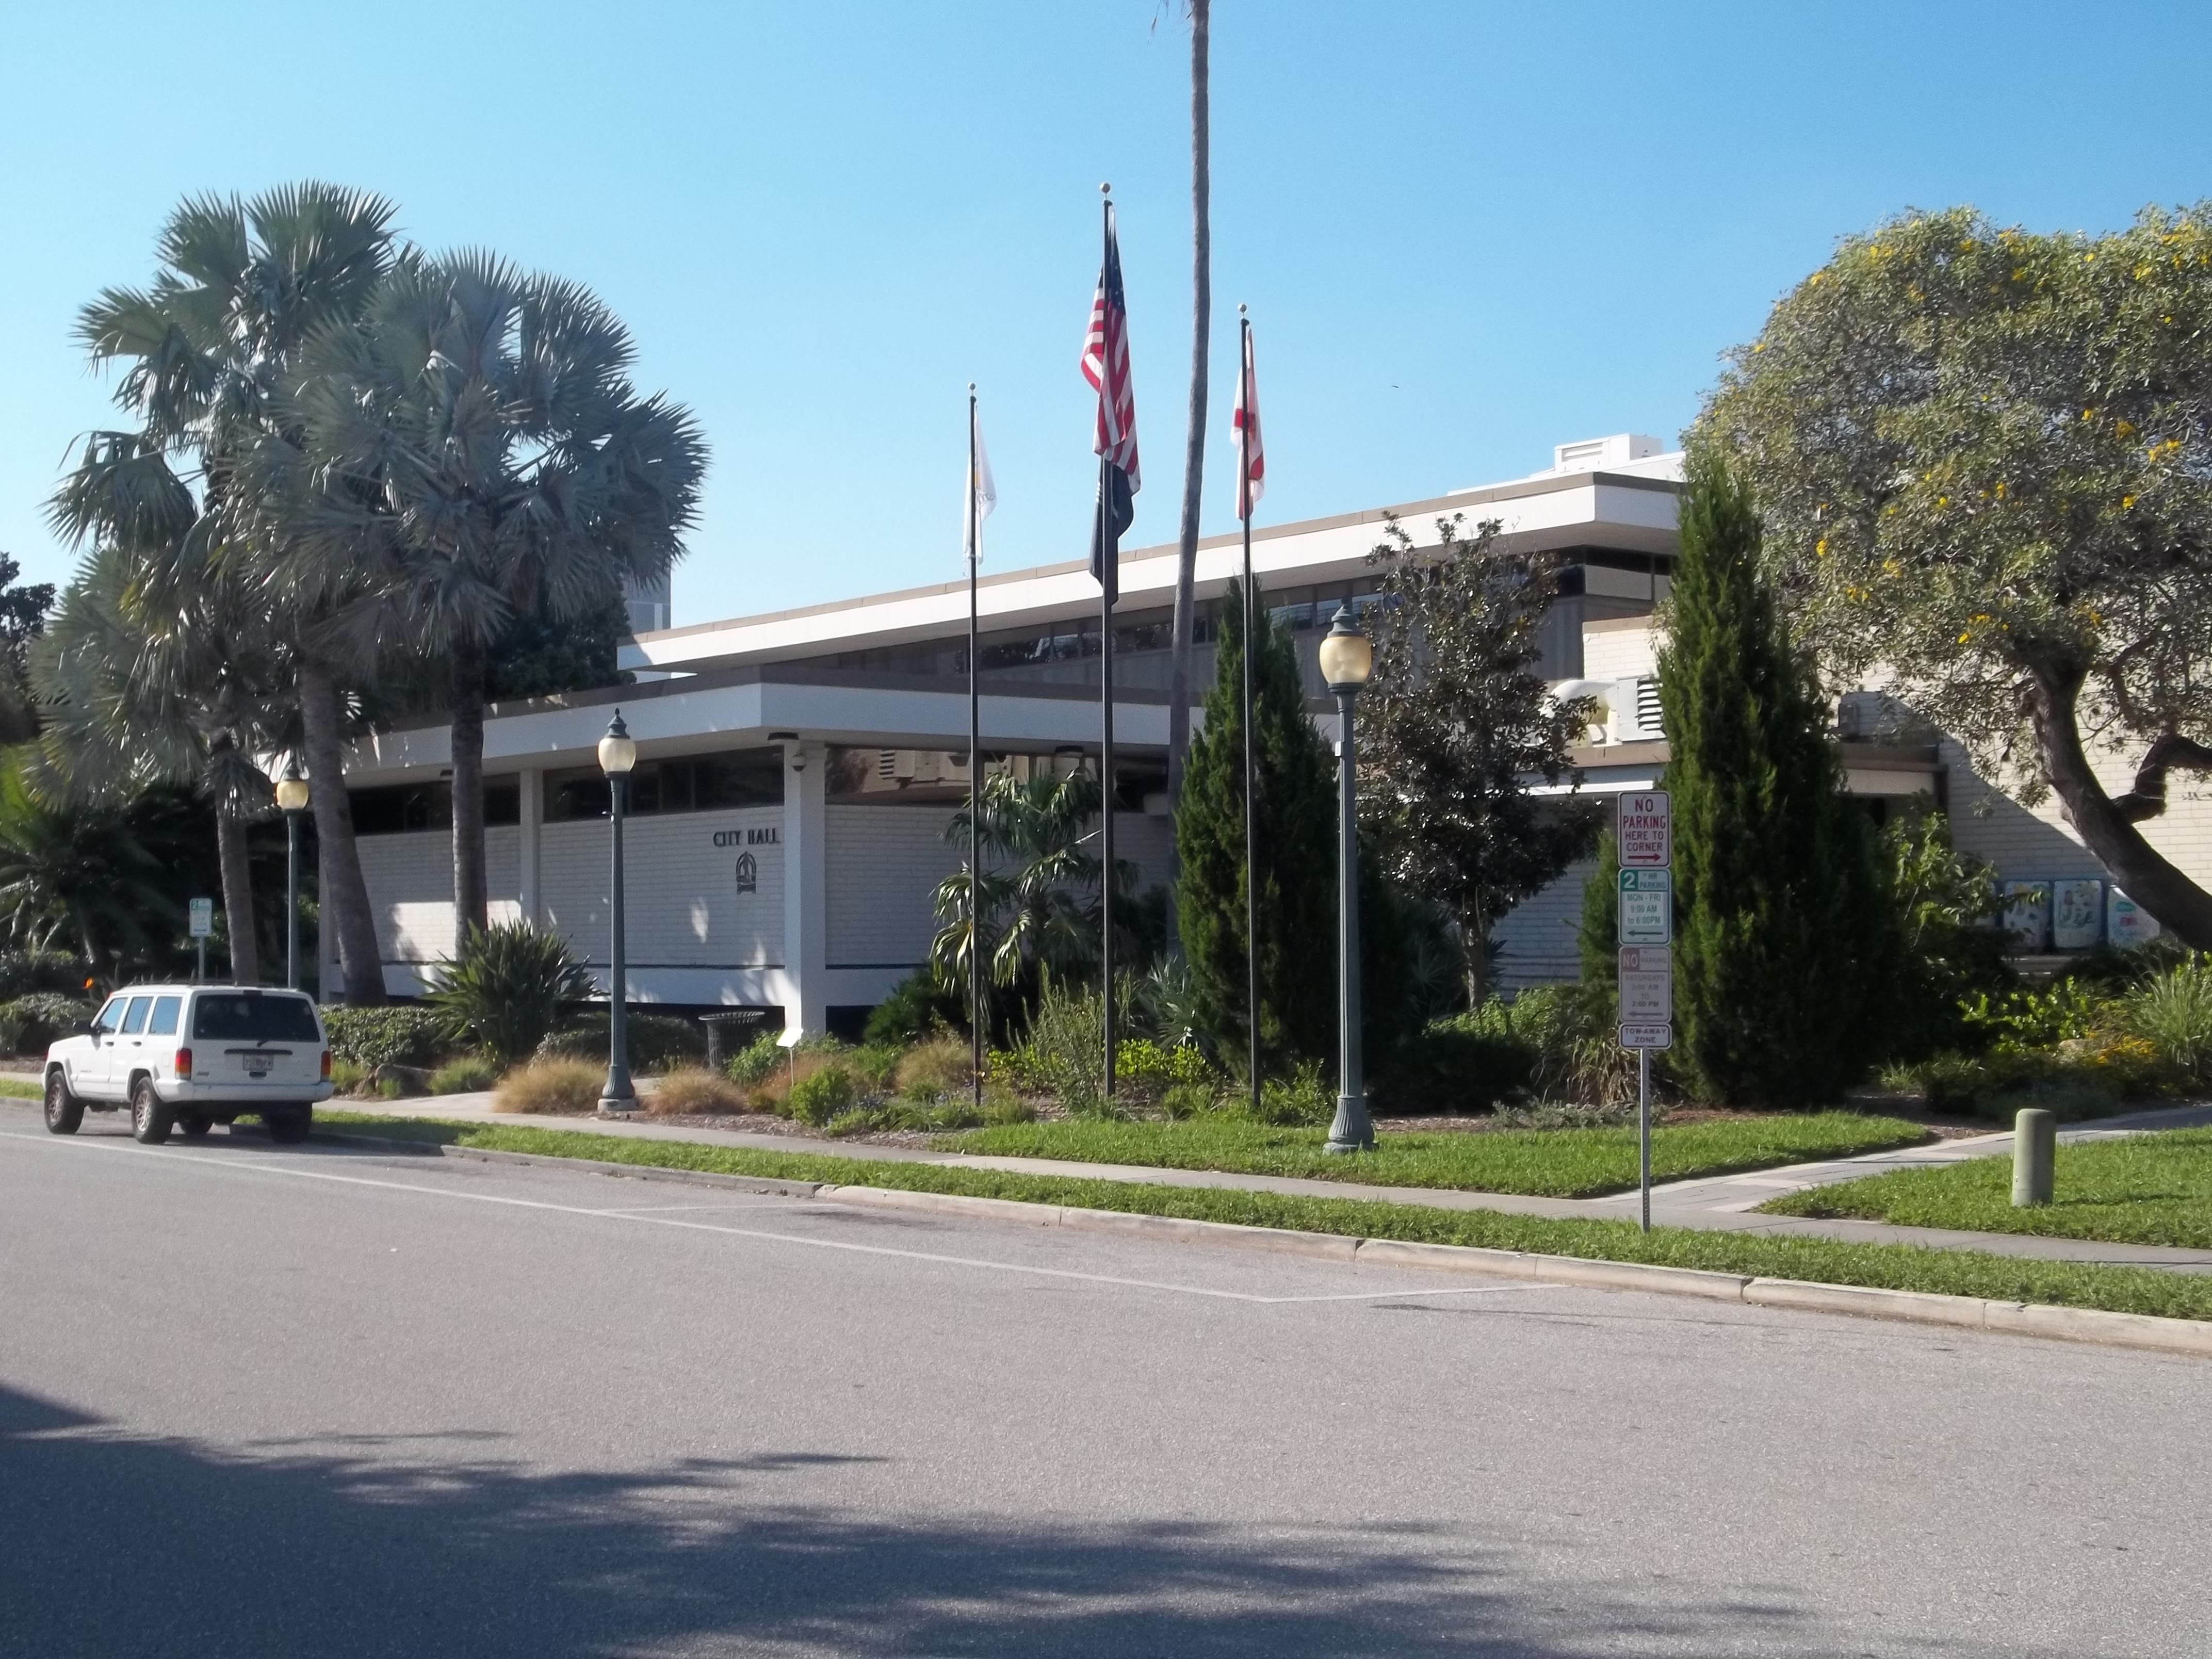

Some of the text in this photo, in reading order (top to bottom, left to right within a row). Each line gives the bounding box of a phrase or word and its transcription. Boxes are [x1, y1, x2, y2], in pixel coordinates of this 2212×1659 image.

[1635, 799, 1653, 812] NO
[1623, 816, 1666, 829] PARKING
[713, 827, 780, 847] CITY HALL
[1625, 831, 1664, 840] HERE TO
[1627, 842, 1663, 851] CORNER
[1624, 872, 1635, 888] 2
[1627, 893, 1643, 902] MON
[1650, 893, 1661, 901] FRI
[1647, 904, 1657, 913] AM
[1623, 954, 1638, 968] NO
